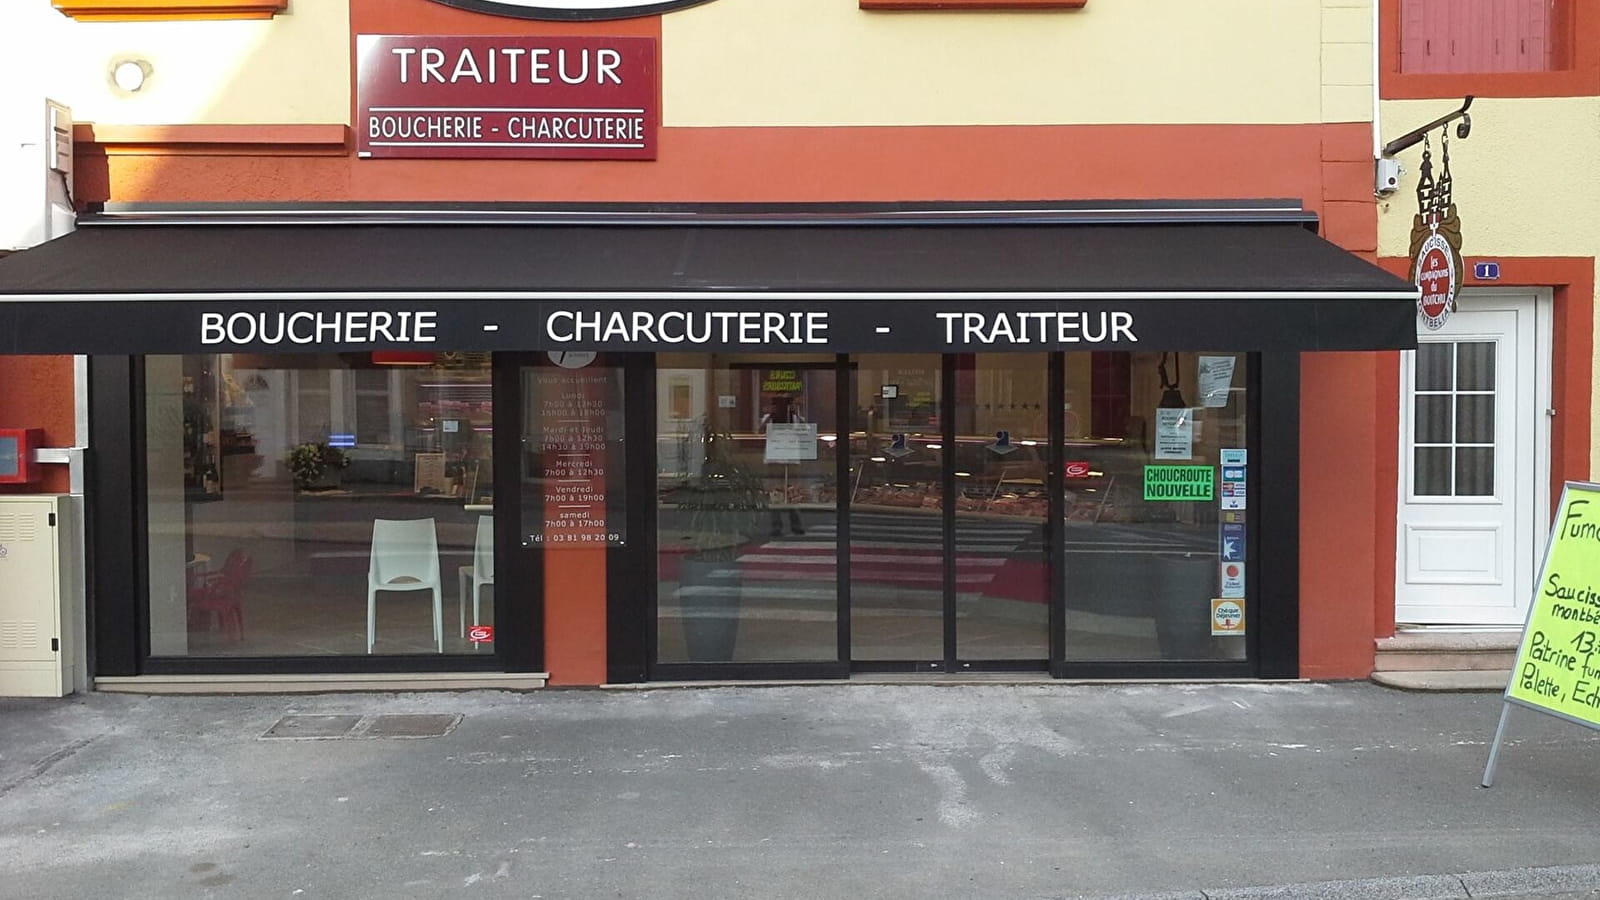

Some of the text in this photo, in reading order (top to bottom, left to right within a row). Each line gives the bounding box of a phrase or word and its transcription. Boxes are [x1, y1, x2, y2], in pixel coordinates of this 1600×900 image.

[391, 47, 622, 85] TRAITEUR
[368, 116, 482, 138] BOUCHERIE
[507, 117, 644, 140] CHARCUTERIE
[1484, 264, 1490, 277] 1
[201, 311, 438, 345] BOUCHERIE
[546, 310, 829, 344] CHARCUTERIE
[936, 311, 1137, 343] TRAITEUR
[545, 468, 604, 477] 7h00 à 12h30
[1146, 468, 1212, 482] CHOUCROUTE
[1146, 483, 1211, 497] NOUVELLE
[570, 493, 575, 501] à
[578, 494, 604, 502] 19h00
[560, 511, 590, 519] samedi
[545, 519, 605, 528] 7h00 à 17h00
[529, 534, 543, 542] Tél
